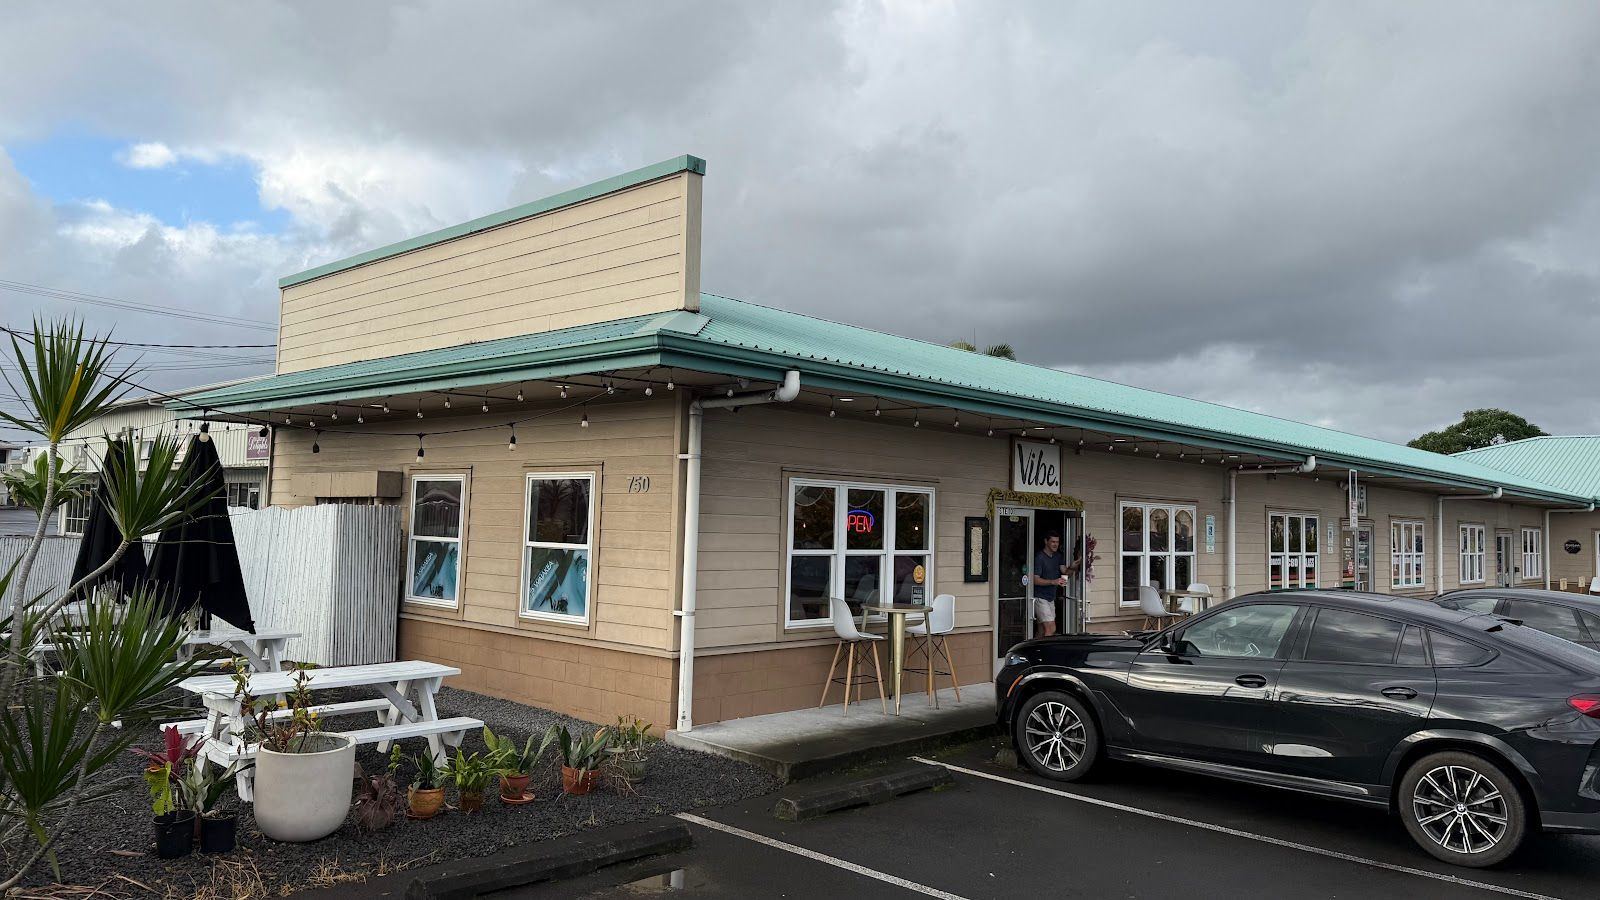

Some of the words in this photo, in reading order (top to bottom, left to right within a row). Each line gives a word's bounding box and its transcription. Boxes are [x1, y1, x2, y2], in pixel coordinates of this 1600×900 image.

[1016, 443, 1059, 487] Vibe.
[626, 475, 650, 493] 750
[847, 514, 872, 533] PEN
